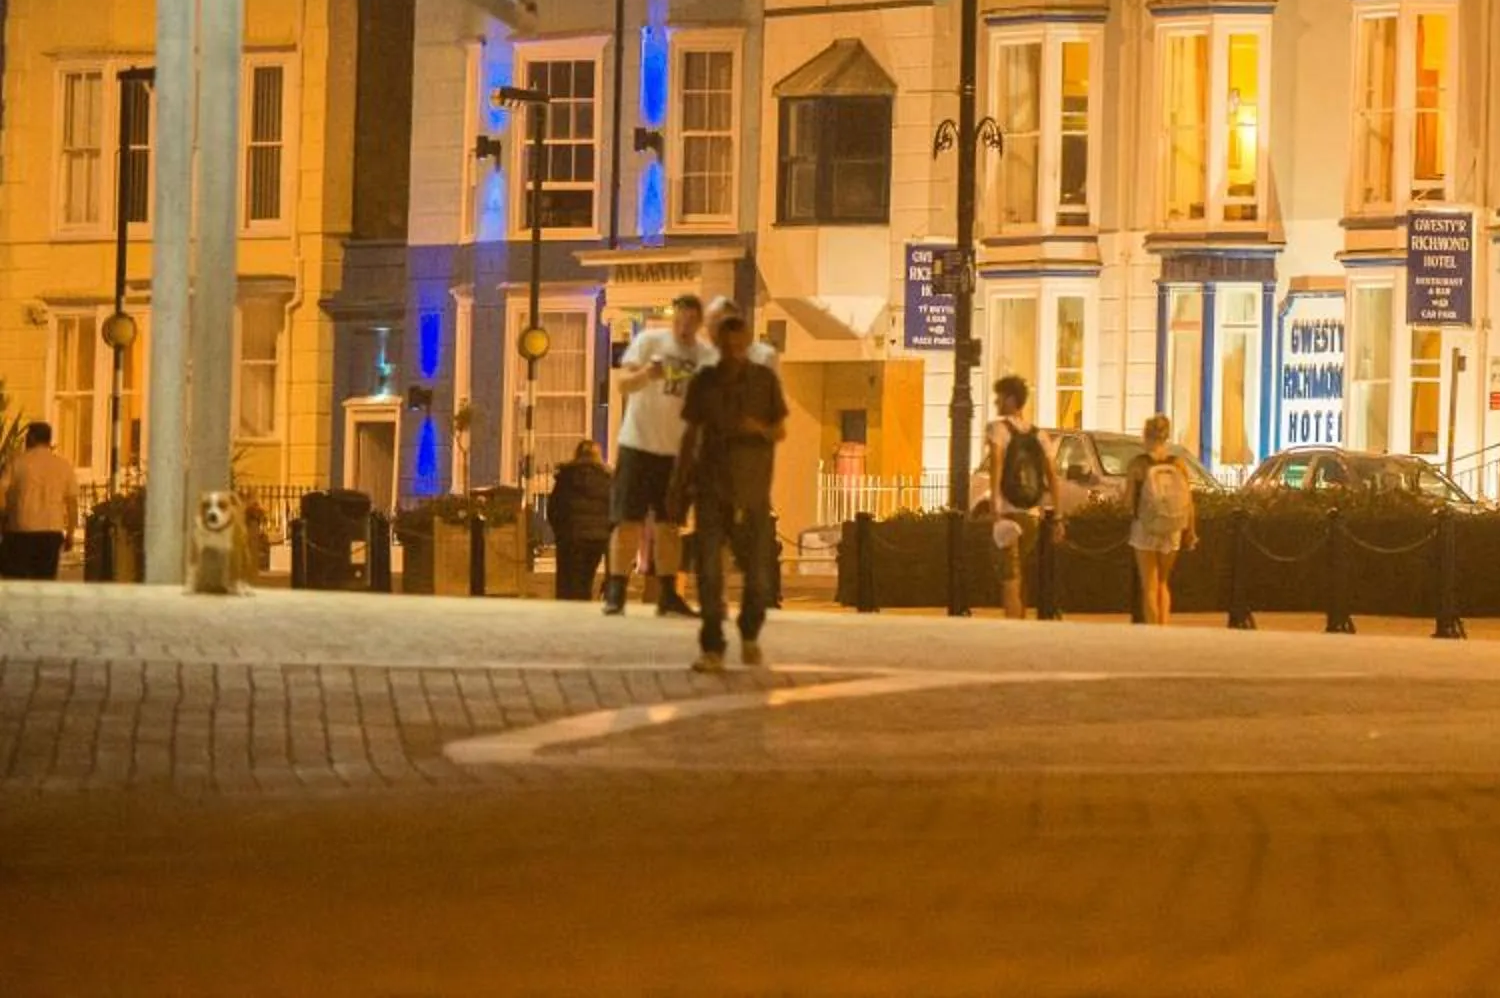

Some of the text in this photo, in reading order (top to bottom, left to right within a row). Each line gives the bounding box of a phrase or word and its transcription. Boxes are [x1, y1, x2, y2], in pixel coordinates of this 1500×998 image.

[1411, 235, 1469, 251] RICHMOND
[1423, 255, 1457, 269] HOTEL
[1421, 310, 1437, 319] CAR
[1283, 363, 1344, 399] RICHMON
